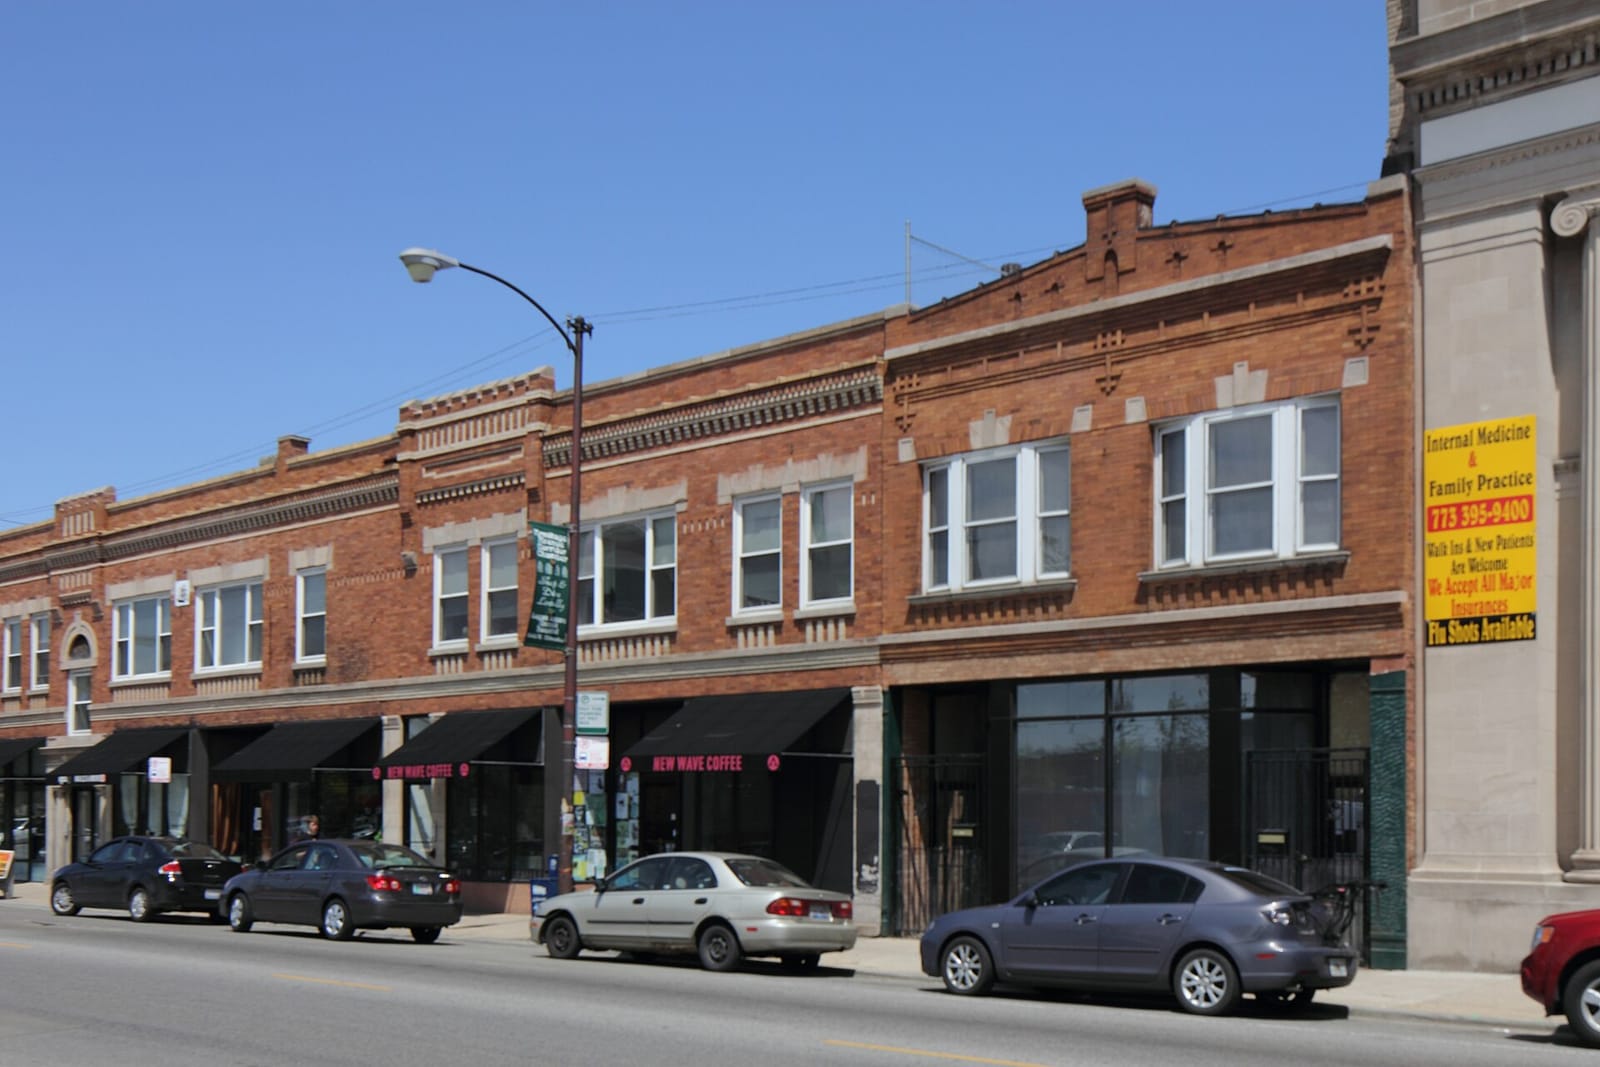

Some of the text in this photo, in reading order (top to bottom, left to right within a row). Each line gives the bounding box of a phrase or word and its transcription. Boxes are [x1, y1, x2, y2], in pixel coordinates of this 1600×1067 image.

[1427, 424, 1531, 453] Internal Medicine
[1468, 450, 1477, 468] &
[1429, 471, 1533, 497] Family Practice
[1431, 498, 1530, 530] 773 395-9400
[1427, 541, 1447, 557] Walk
[1450, 539, 1464, 555] Ins
[1475, 537, 1494, 552] New
[1496, 533, 1534, 550] Patients
[1451, 557, 1508, 575] Are Welcome
[1428, 572, 1533, 598] We Accept All Major
[1451, 598, 1508, 617] Insurances
[1428, 614, 1535, 645] Flu Shots Available
[387, 763, 453, 779] NEW WAVE COFFEE
[653, 755, 743, 771] NEW WAVE COFFEE
